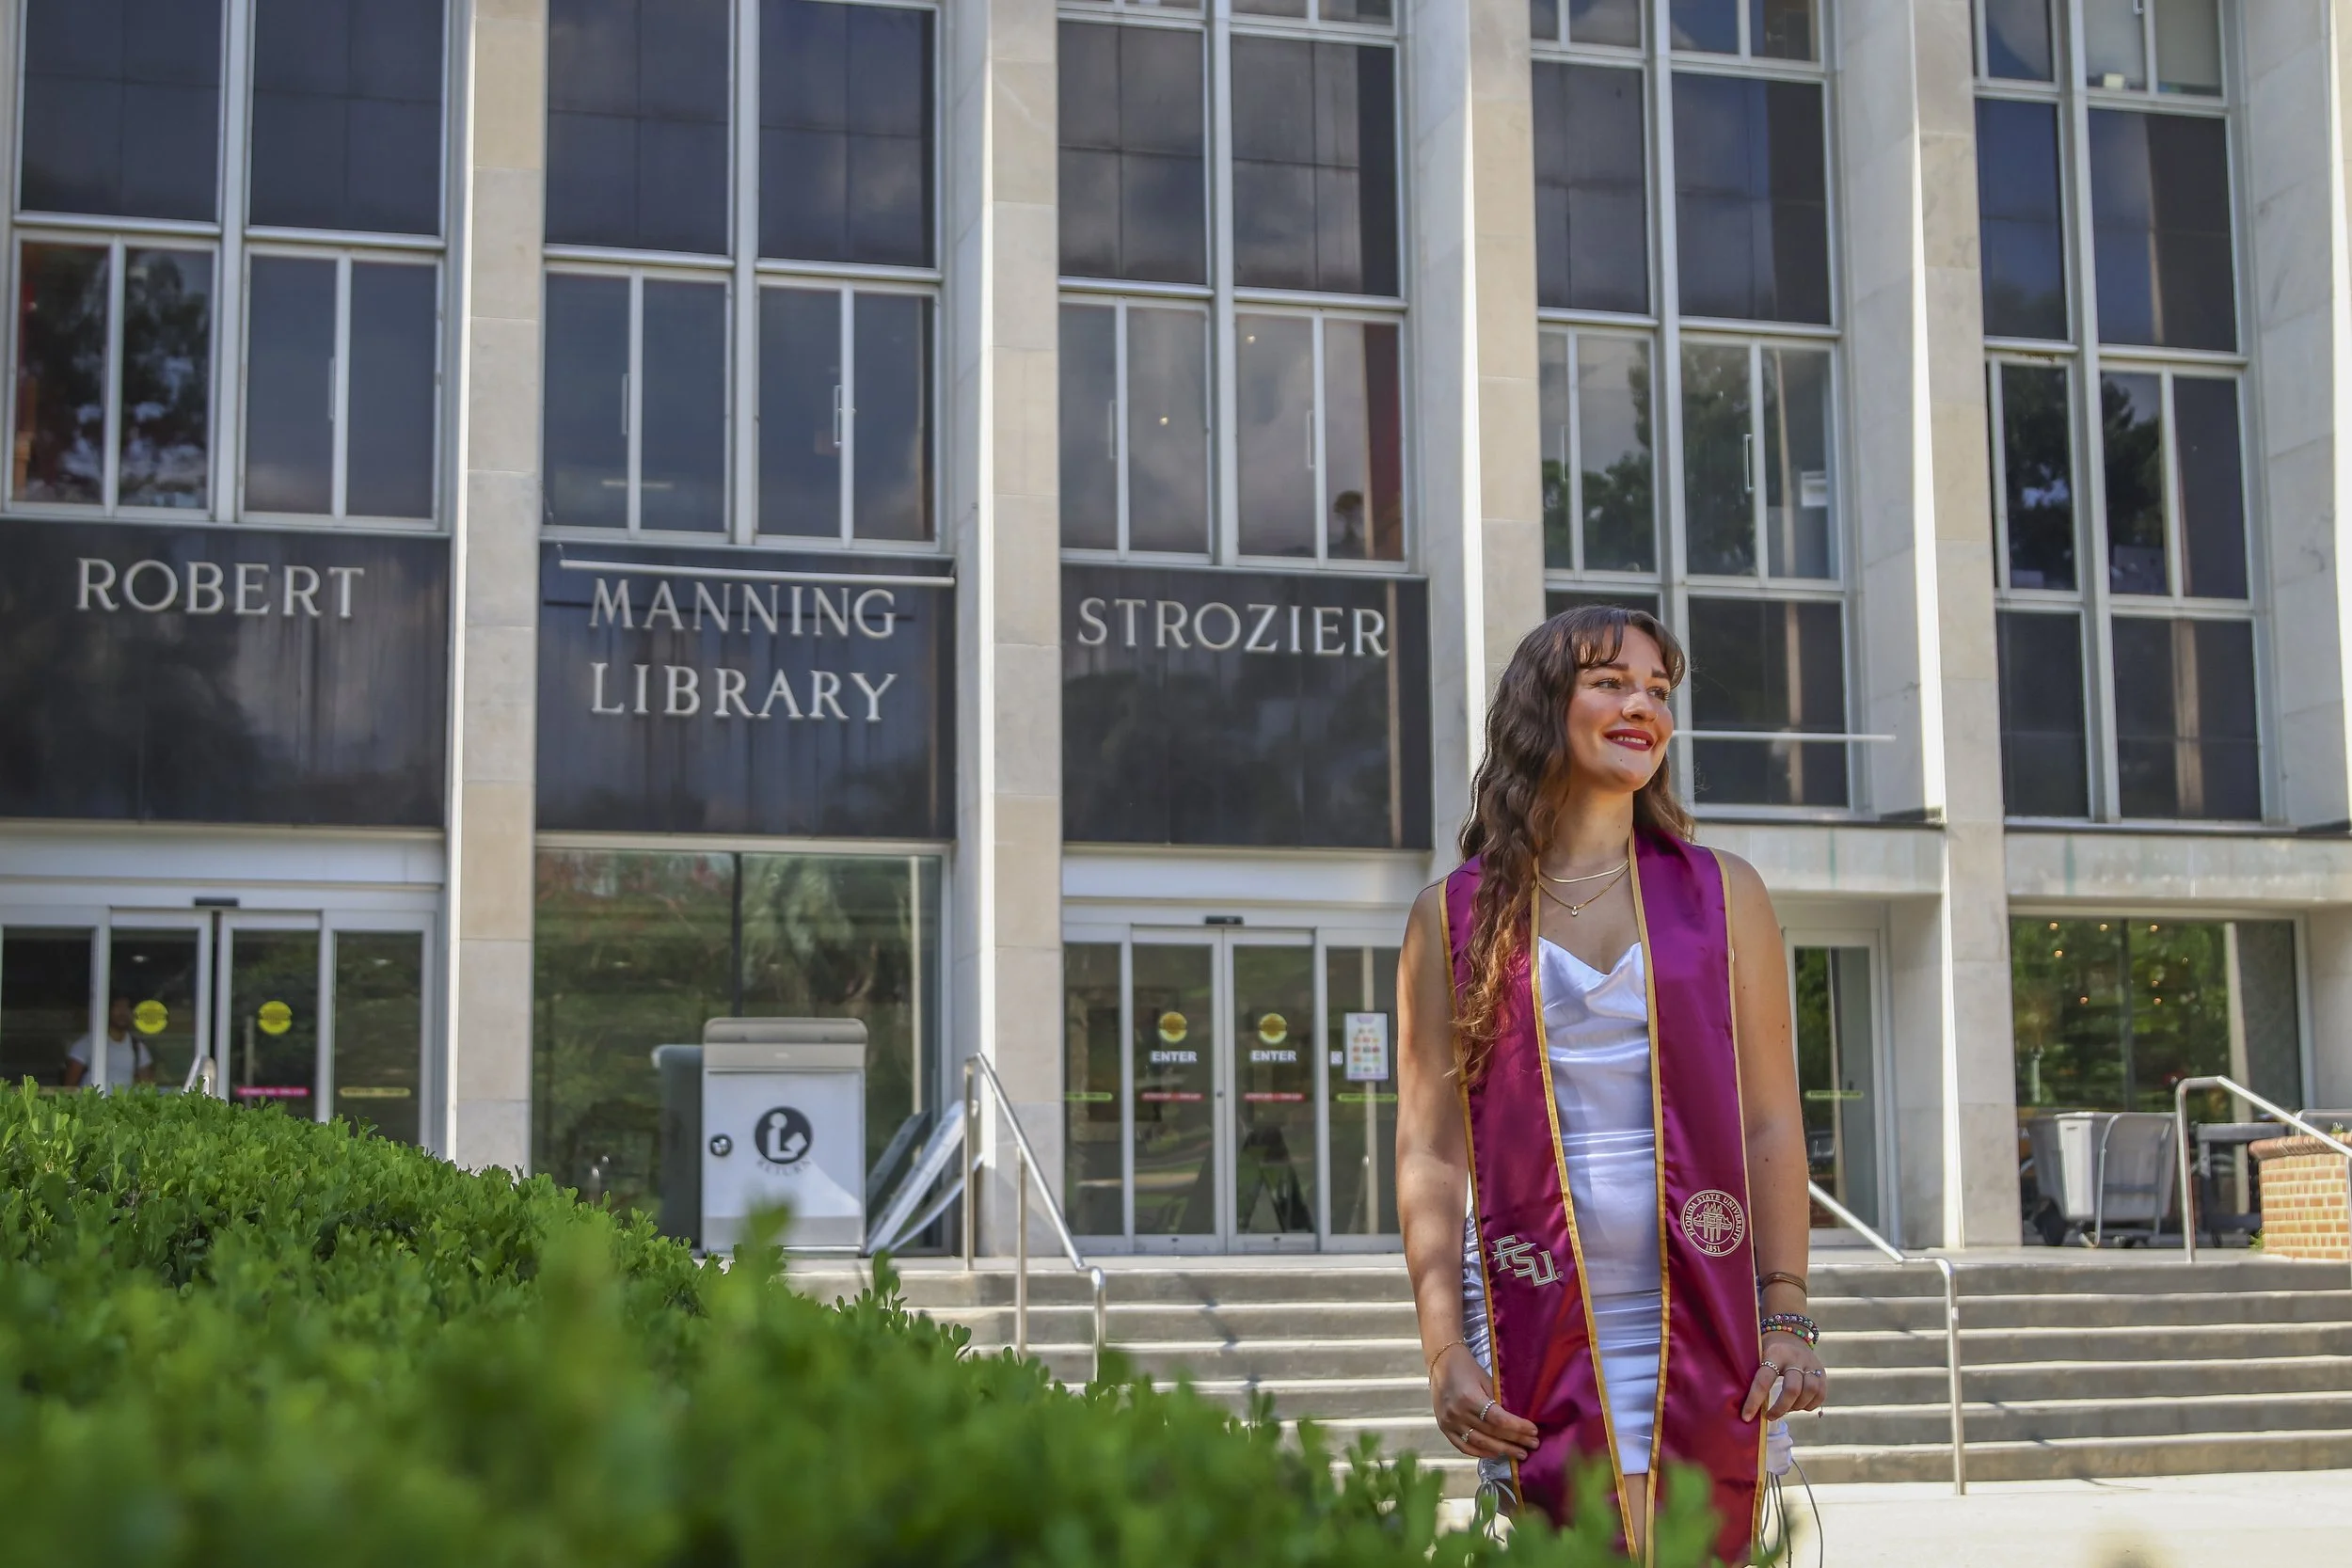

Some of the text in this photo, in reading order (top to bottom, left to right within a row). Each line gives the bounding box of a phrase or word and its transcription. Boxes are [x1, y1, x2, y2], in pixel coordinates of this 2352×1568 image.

[77, 557, 365, 619] ROBERT
[588, 577, 897, 640] MANNING
[1077, 597, 1390, 657] STROZIER
[591, 662, 898, 721] LIBRARY
[1150, 1050, 1198, 1063] ENTER
[1250, 1050, 1297, 1063] ENTER
[1685, 1194, 1742, 1243] FLORIDA STATE UNIVERSITY
[1491, 1234, 1560, 1287] FSU
[1705, 1243, 1721, 1253] 1851
